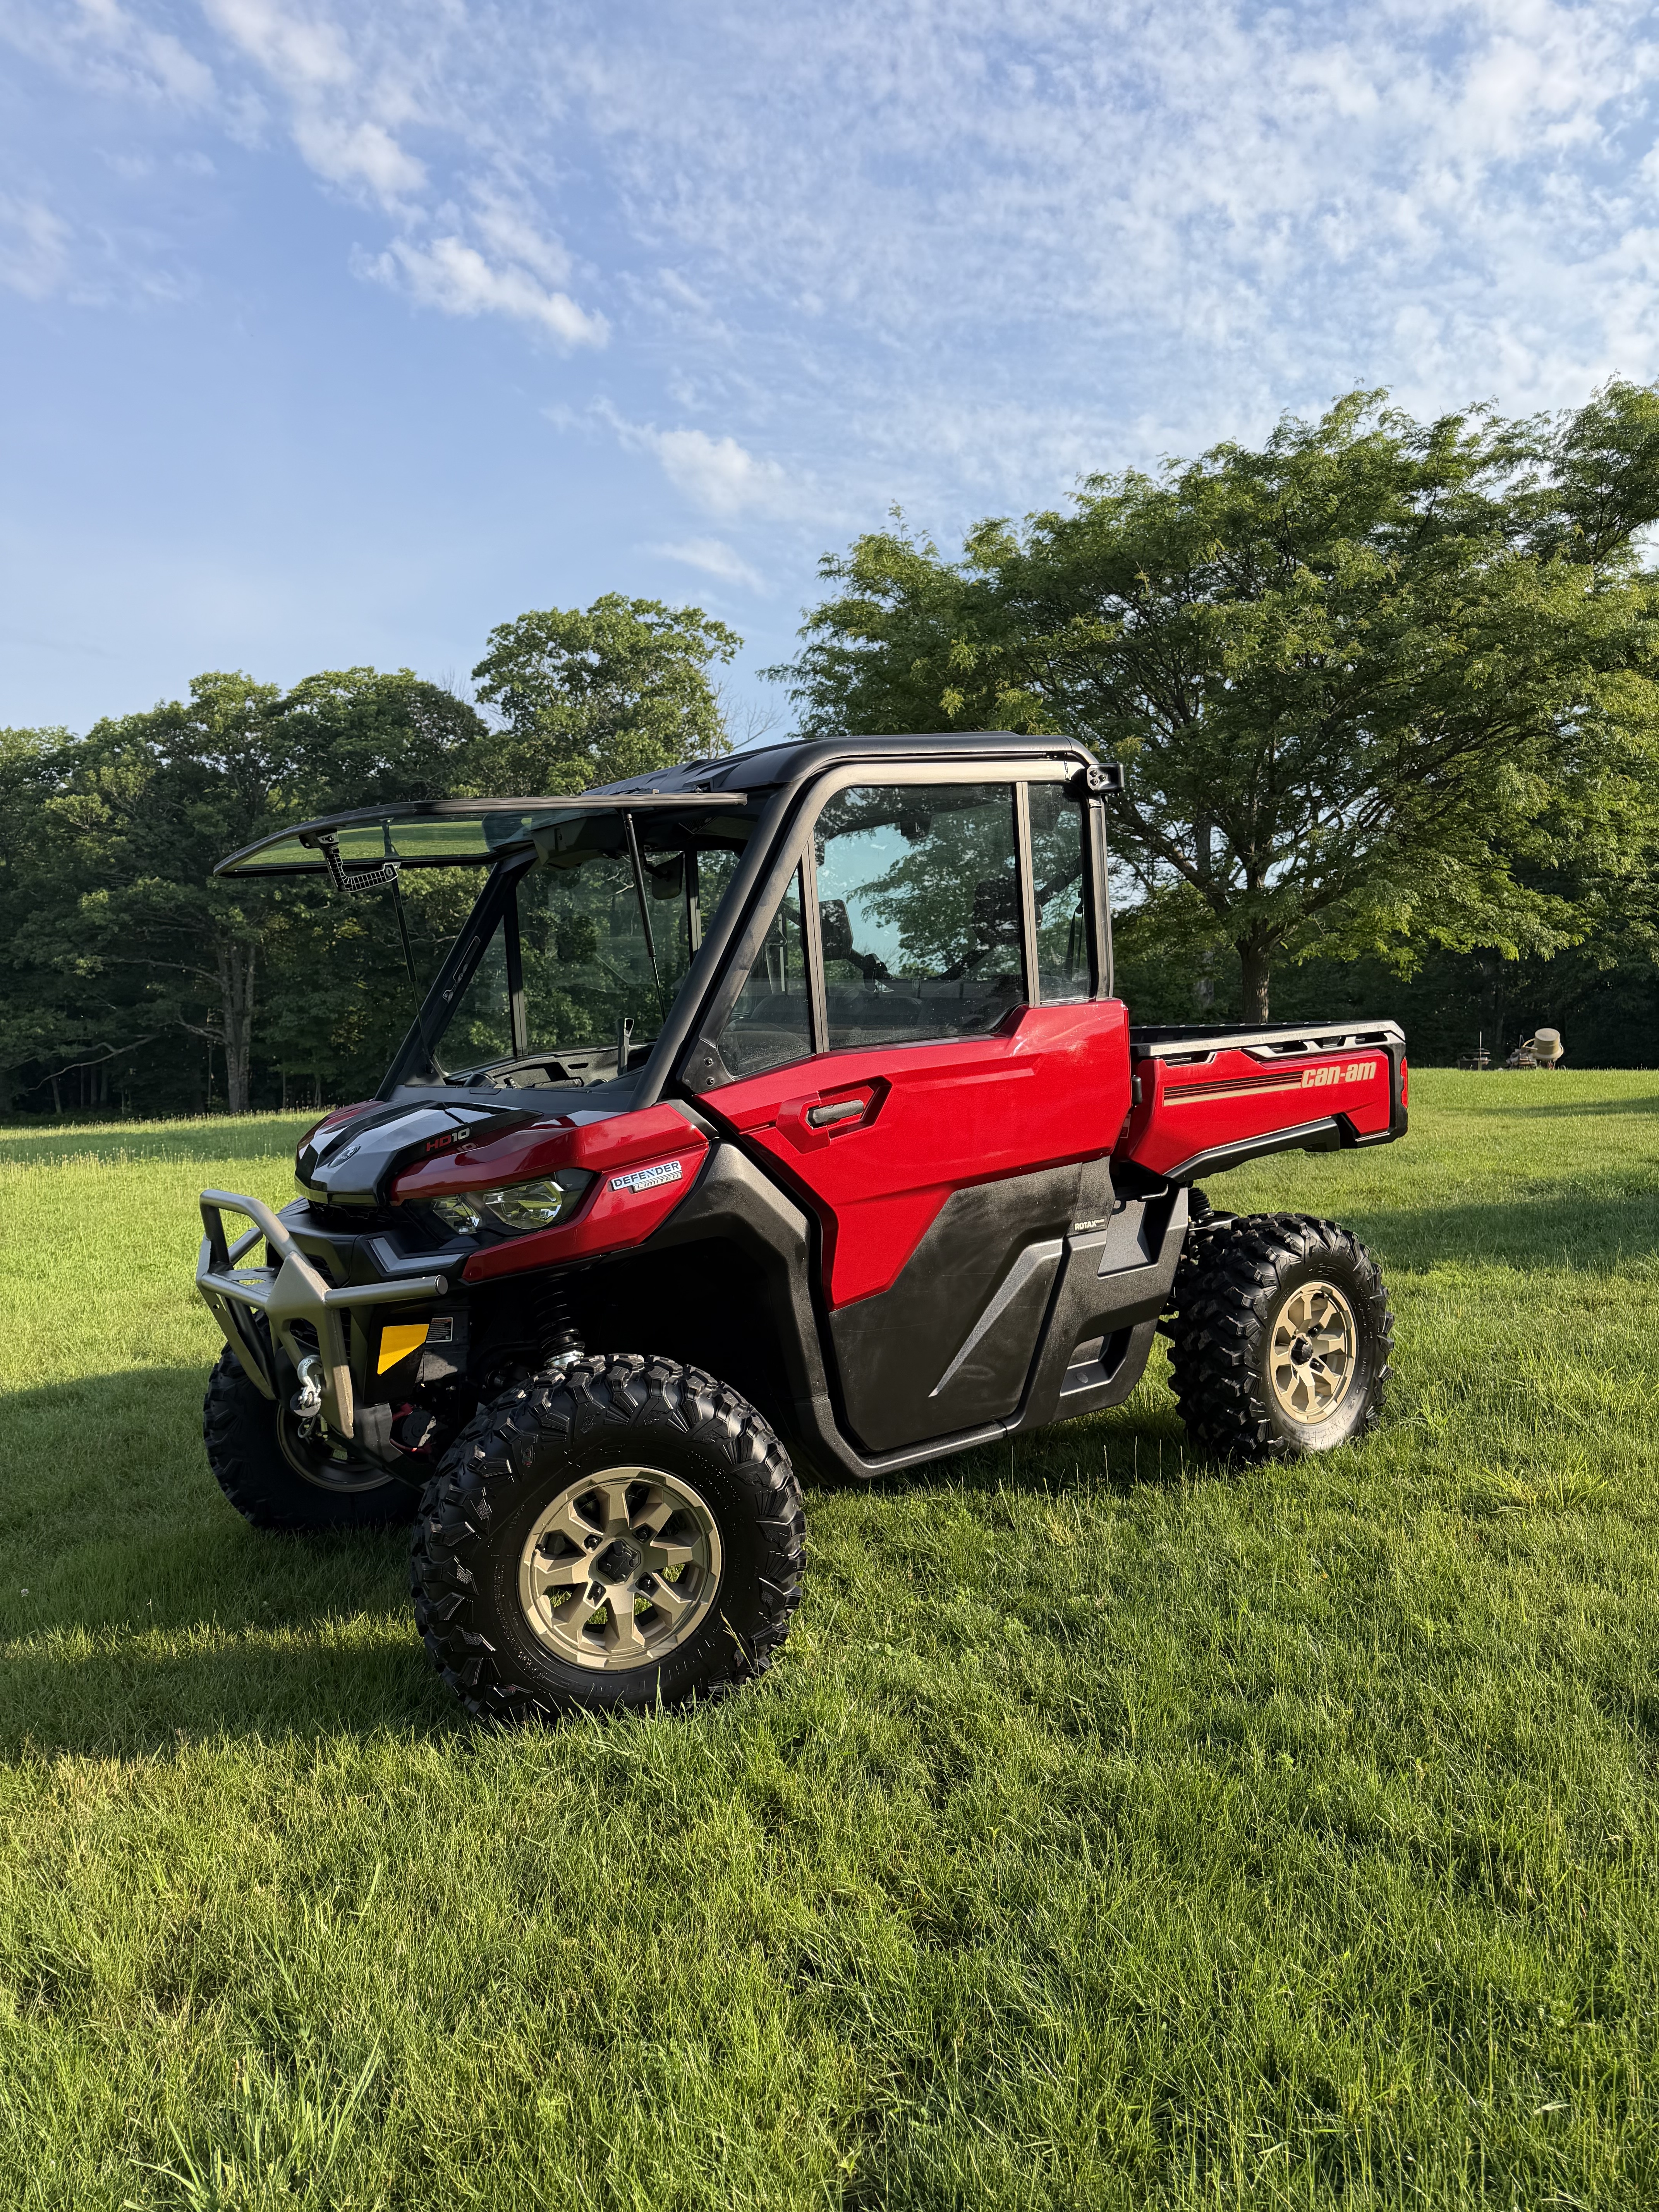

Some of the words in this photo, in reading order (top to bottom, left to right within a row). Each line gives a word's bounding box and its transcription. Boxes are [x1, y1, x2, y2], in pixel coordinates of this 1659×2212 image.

[1302, 1062, 1376, 1088] can-am
[426, 1128, 470, 1152] HD10
[614, 1162, 680, 1187] DEFENDER
[637, 1174, 679, 1189] LIMITED
[1075, 1220, 1097, 1230] ROTAX
